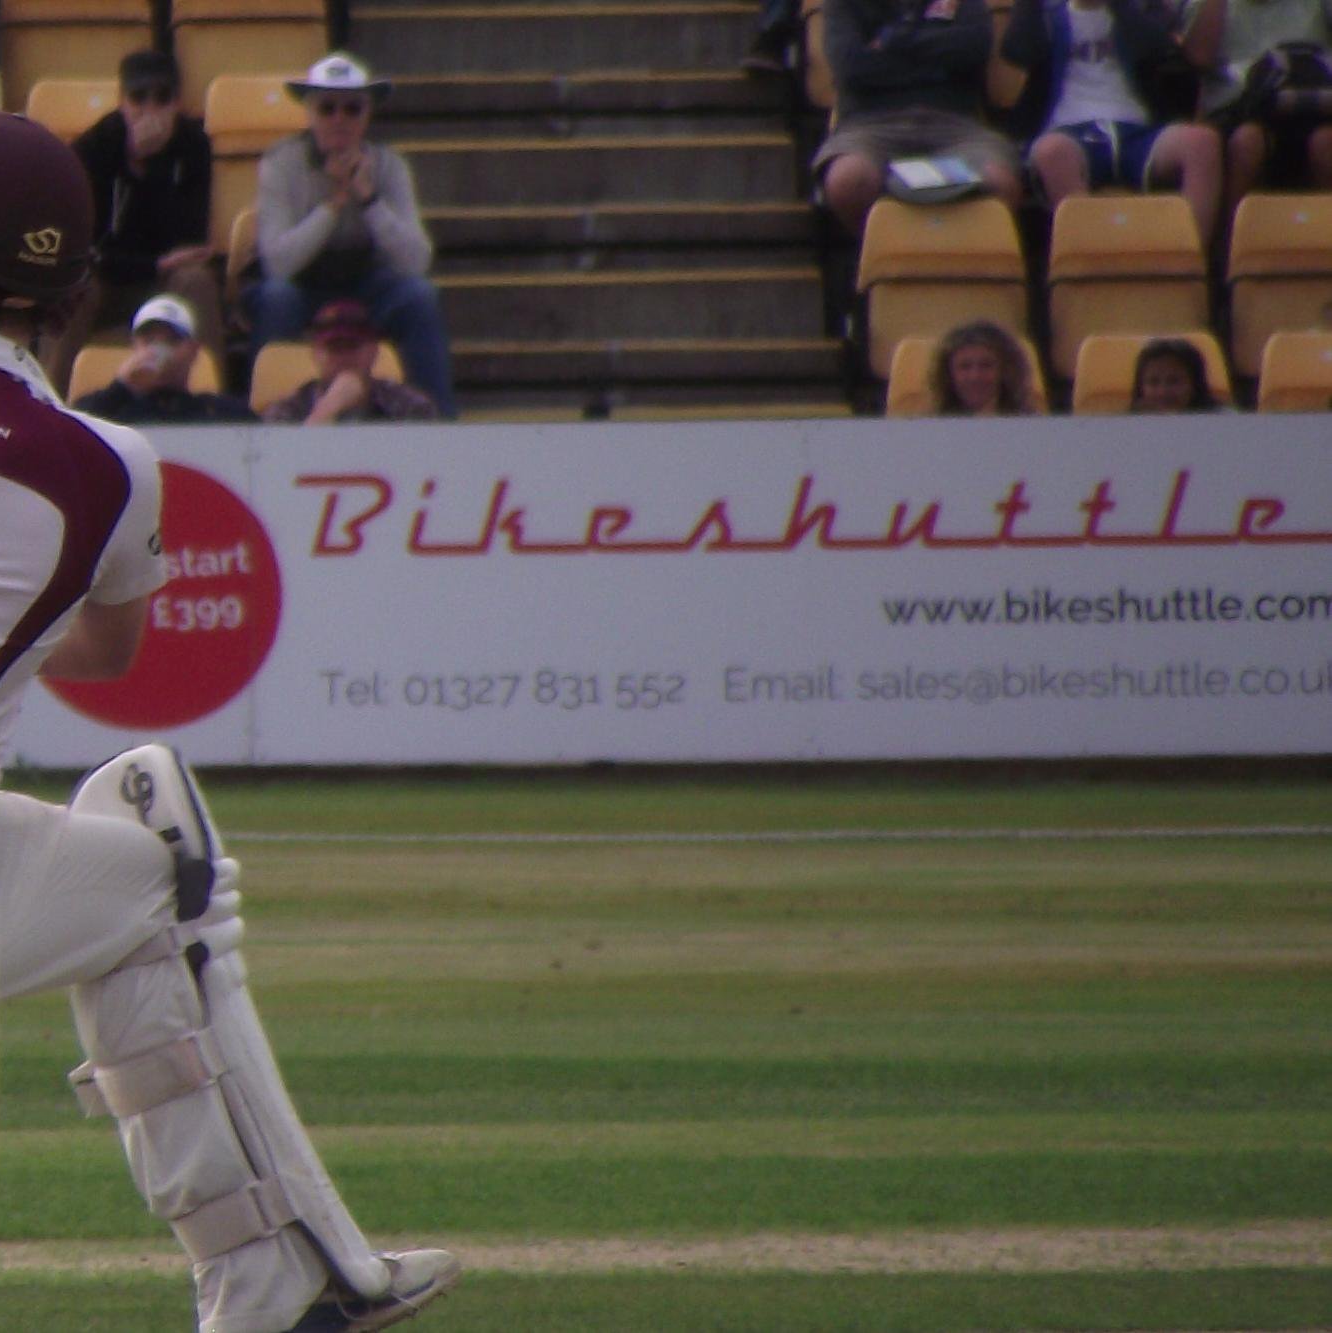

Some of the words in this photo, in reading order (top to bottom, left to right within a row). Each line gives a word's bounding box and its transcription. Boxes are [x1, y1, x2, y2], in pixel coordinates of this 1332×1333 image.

[294, 467, 1332, 557] Bikeshuttle
[162, 541, 251, 578] start
[151, 594, 244, 632] £399
[402, 673, 522, 712] 01327
[532, 668, 602, 711] 831
[614, 673, 686, 711] 552
